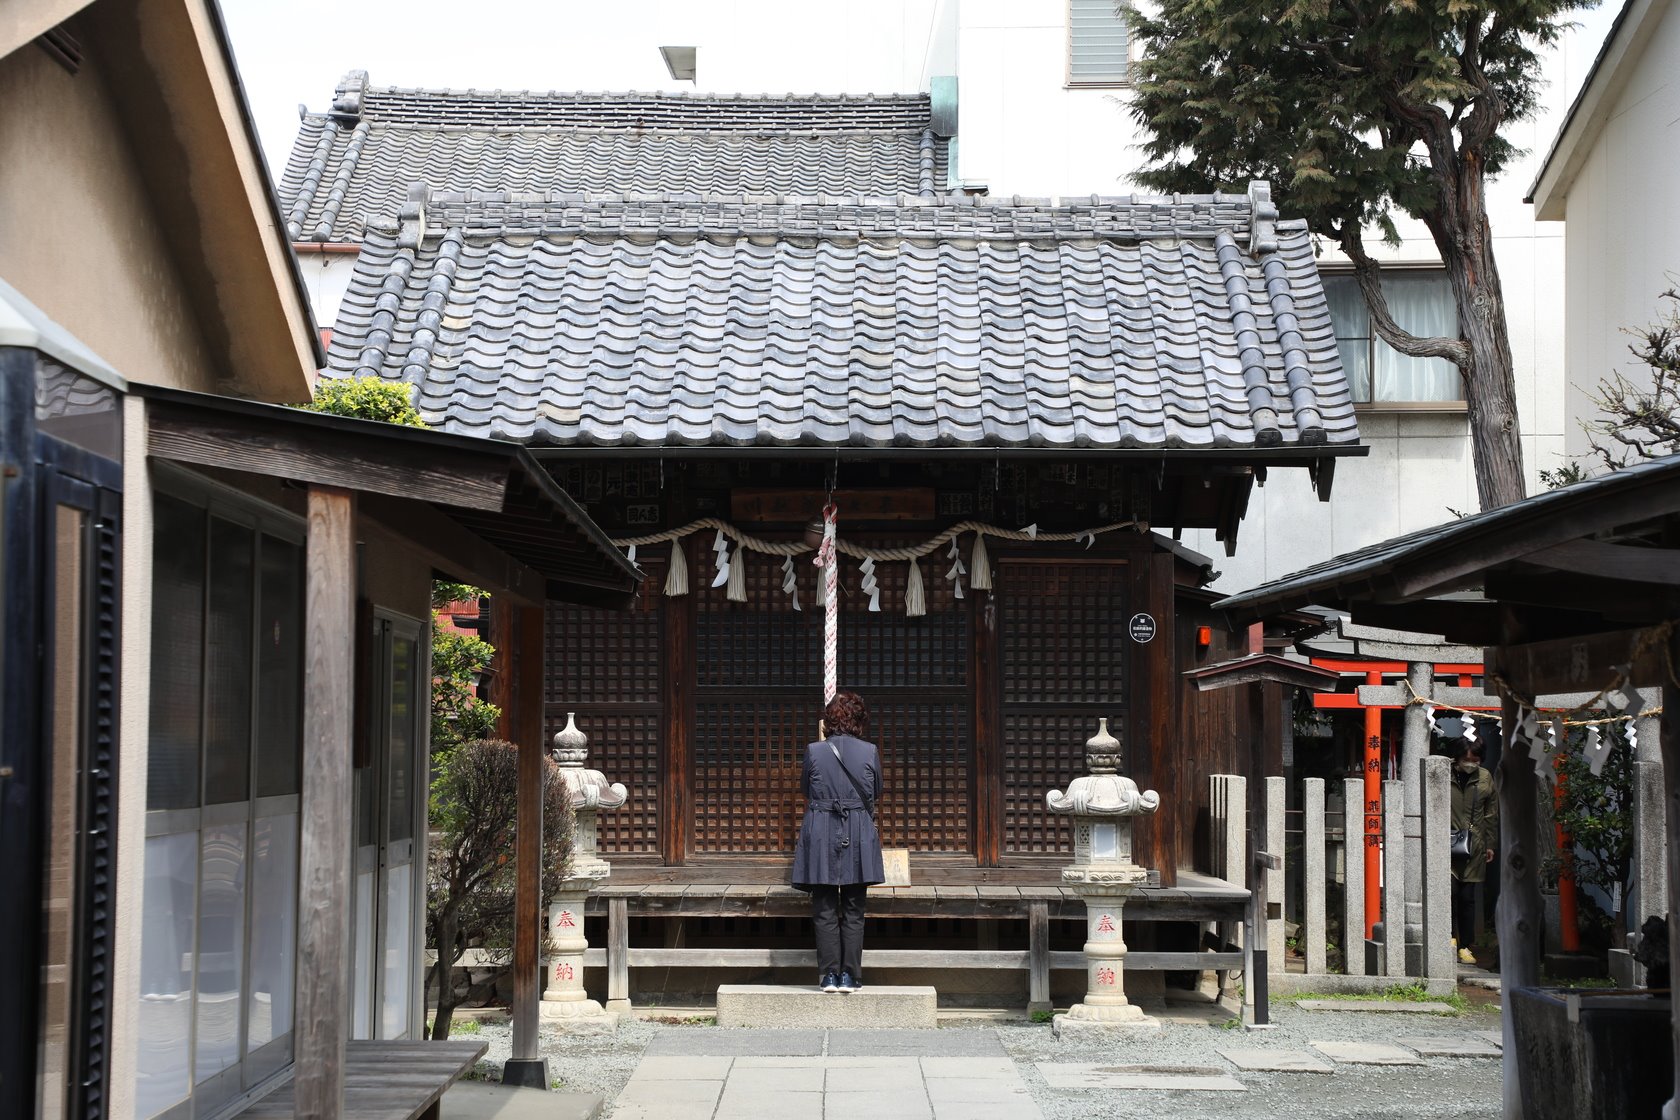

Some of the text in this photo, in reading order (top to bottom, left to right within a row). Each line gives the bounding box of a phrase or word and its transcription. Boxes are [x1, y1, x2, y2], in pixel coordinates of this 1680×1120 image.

[1368, 735, 1380, 772] 奉納
[556, 910, 576, 981] 奉納
[1097, 915, 1116, 986] 奉納
